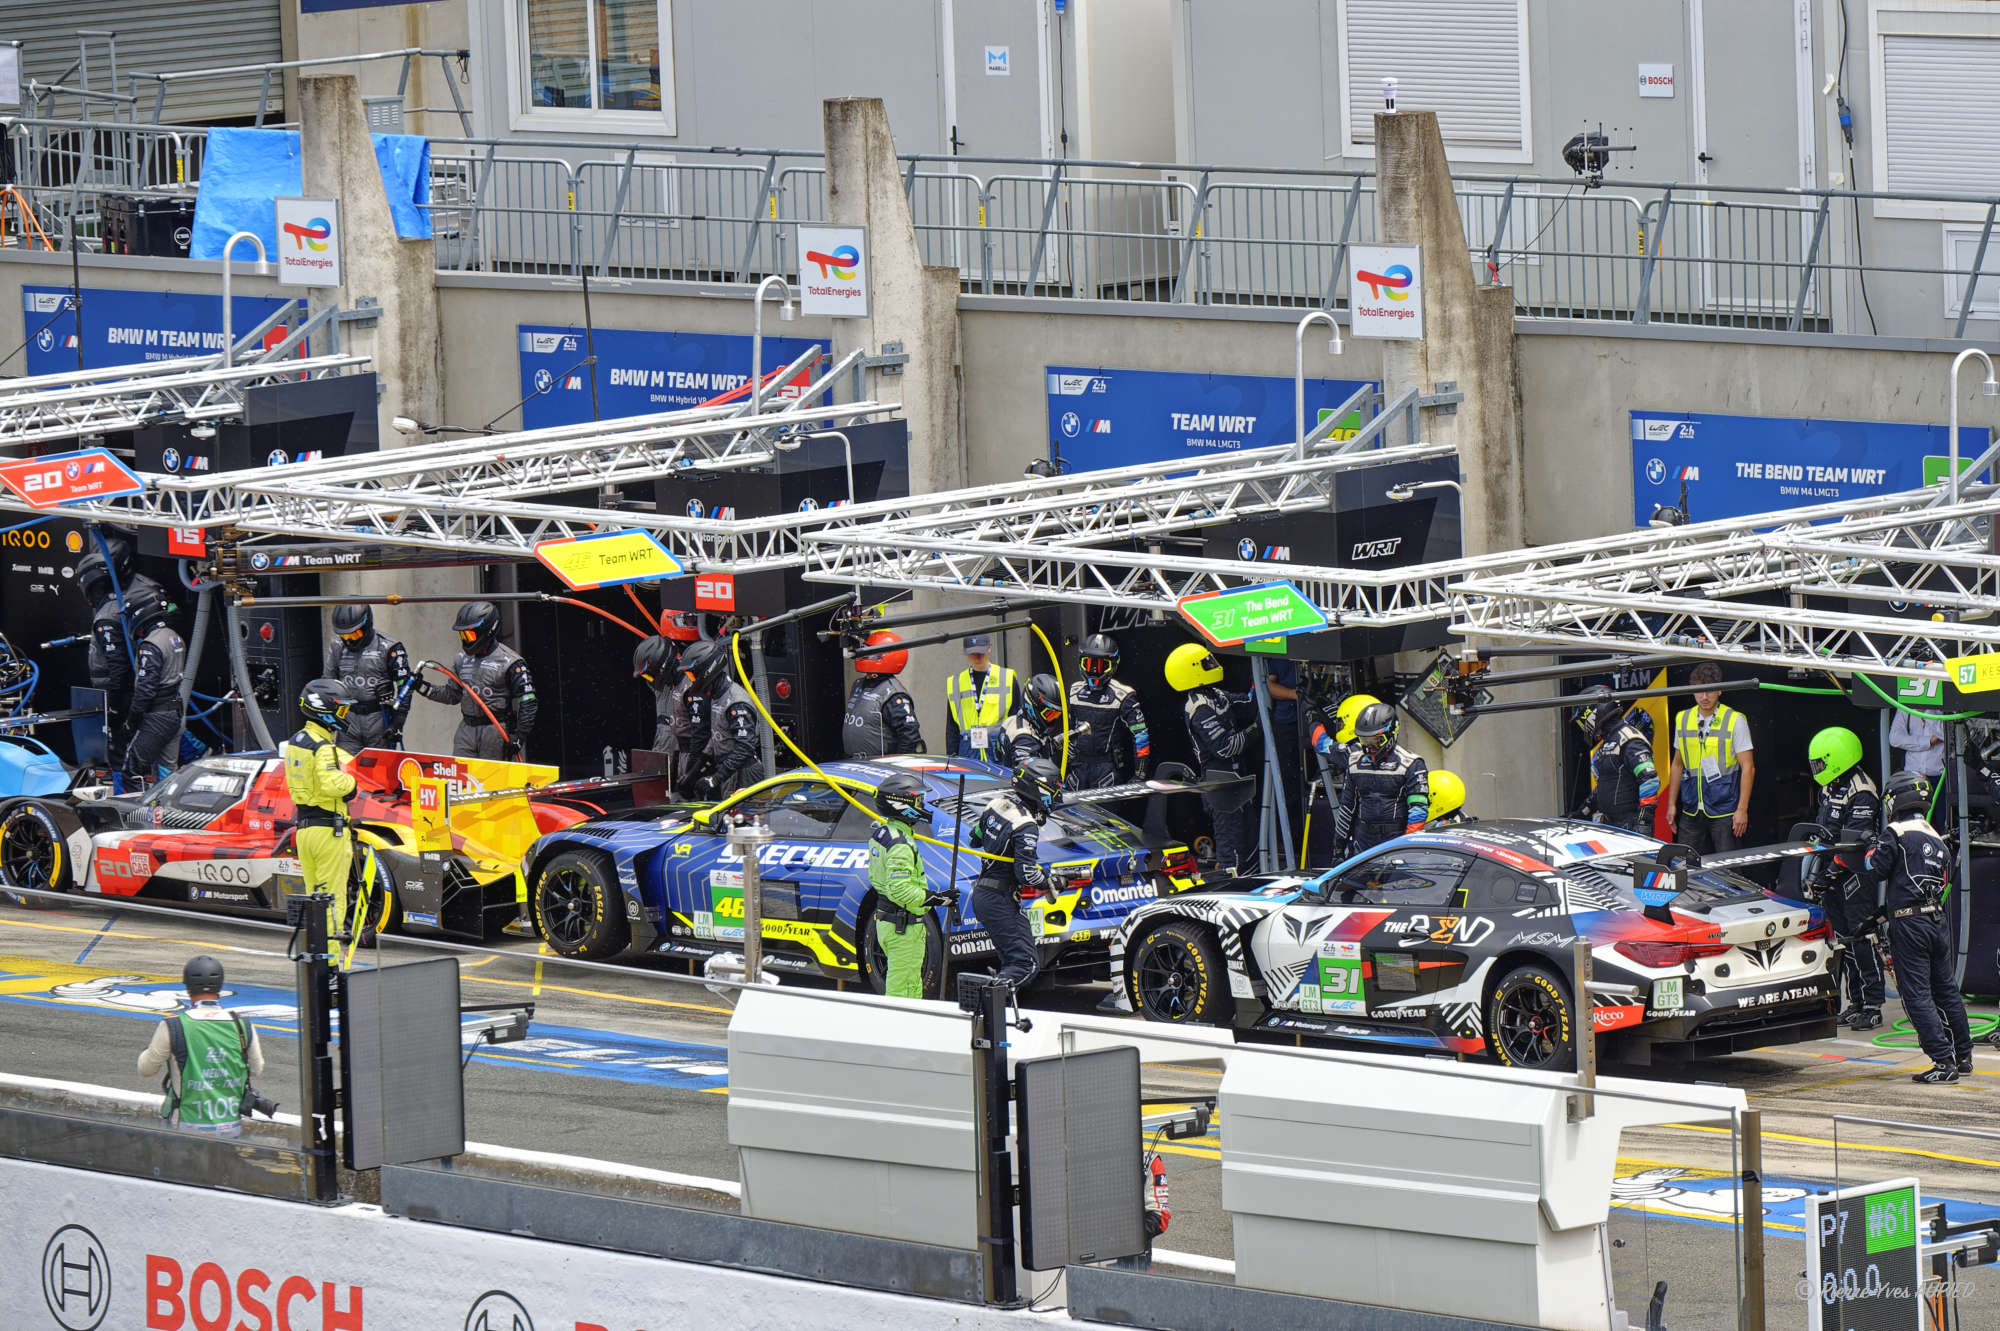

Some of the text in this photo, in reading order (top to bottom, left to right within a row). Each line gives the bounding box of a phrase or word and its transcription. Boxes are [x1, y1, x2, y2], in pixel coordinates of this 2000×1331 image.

[1648, 76, 1673, 85] BOSCH
[284, 256, 334, 269] TotalEnergies
[807, 286, 862, 298] TotalEnergies
[1357, 304, 1415, 320] TotalEnergies
[108, 327, 142, 345] BMW
[145, 329, 158, 346] M
[160, 329, 203, 348] TEAM
[610, 368, 748, 391] BMW M TEAM WRT
[650, 393, 667, 403] BMW
[669, 394, 675, 403] M
[676, 394, 697, 405] Hybrid
[1171, 412, 1257, 434] TEAM WRT
[1186, 437, 1241, 449] BMW M4 LMGT3
[24, 470, 63, 492] 20
[1735, 462, 1886, 485] THE BEND TEAM WRT
[70, 481, 104, 493] Team WRT
[1780, 486, 1839, 498] BMW M4 LMGT3
[173, 527, 200, 545] 15
[599, 553, 627, 566] Team
[629, 548, 654, 562] WRT
[1352, 537, 1402, 560] WRT
[303, 554, 333, 566] Team
[335, 553, 362, 565] WRT
[696, 581, 733, 600] 20
[1244, 594, 1289, 612] The Bend
[1240, 615, 1269, 628] Team
[1270, 608, 1294, 623] WRT
[1612, 671, 1651, 690] TEAM
[1959, 665, 1976, 683] 57
[1899, 677, 1939, 698] 31
[433, 762, 457, 777] Shell
[419, 786, 437, 806] HY
[100, 853, 149, 877] 20 HYPER
[131, 863, 151, 876] CAR
[197, 861, 250, 885] iQOO
[213, 890, 249, 901] Motorsport
[1090, 879, 1159, 905] Omantel
[714, 896, 744, 919] 46
[1384, 920, 1409, 933] THE
[1322, 966, 1361, 994] 31
[1659, 980, 1678, 994] LM
[1304, 985, 1317, 998] LM
[1657, 993, 1681, 1008] GT3
[1738, 985, 1818, 1009] WE ARE A TEAM
[1302, 998, 1320, 1012] GT3
[1593, 1009, 1625, 1027] Ricco
[192, 1096, 240, 1121] 1106
[1820, 1199, 1910, 1248] P7 #61
[146, 1254, 363, 1331] BOSCH
